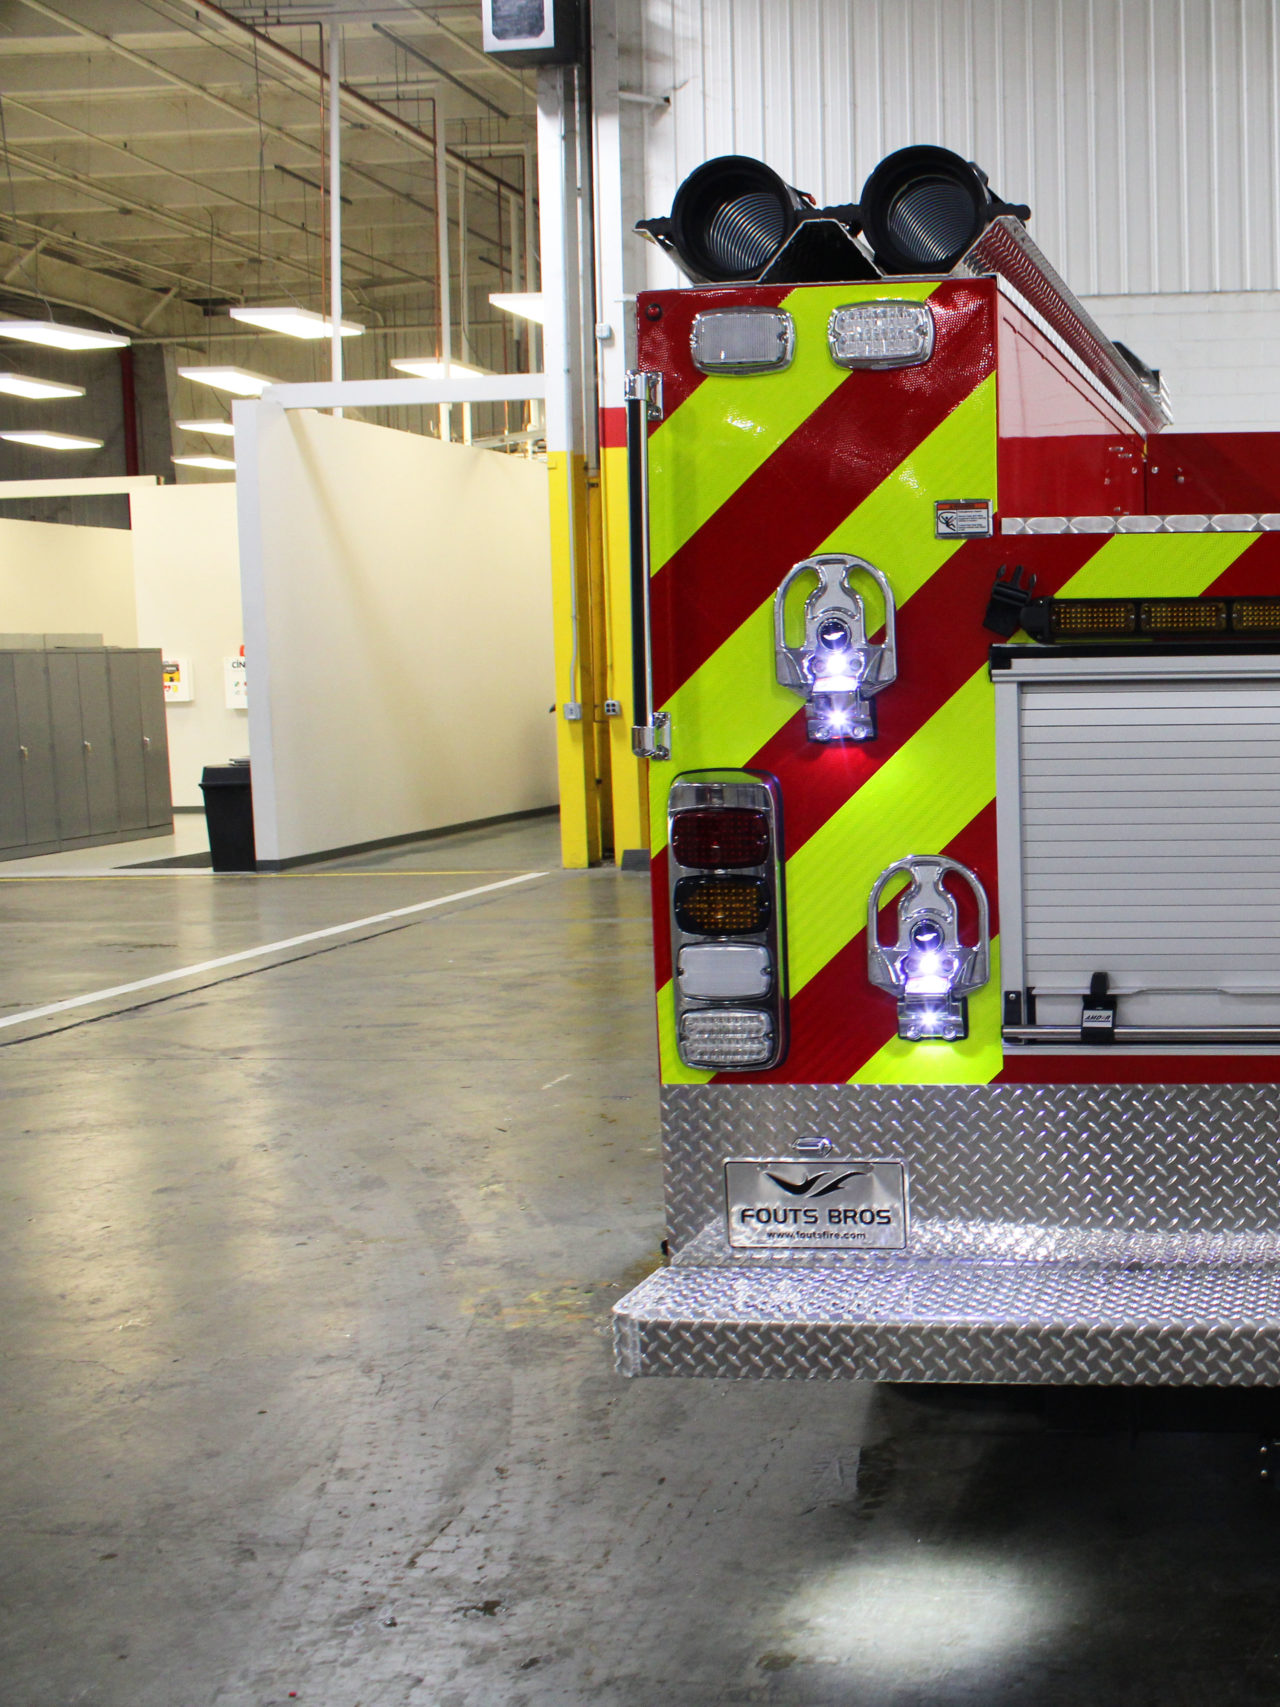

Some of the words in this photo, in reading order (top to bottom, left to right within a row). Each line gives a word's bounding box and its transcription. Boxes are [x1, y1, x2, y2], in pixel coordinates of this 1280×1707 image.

[740, 1208, 819, 1225] FOUTS
[828, 1208, 892, 1225] BROS
[767, 1230, 867, 1240] www.foutsfire.com
